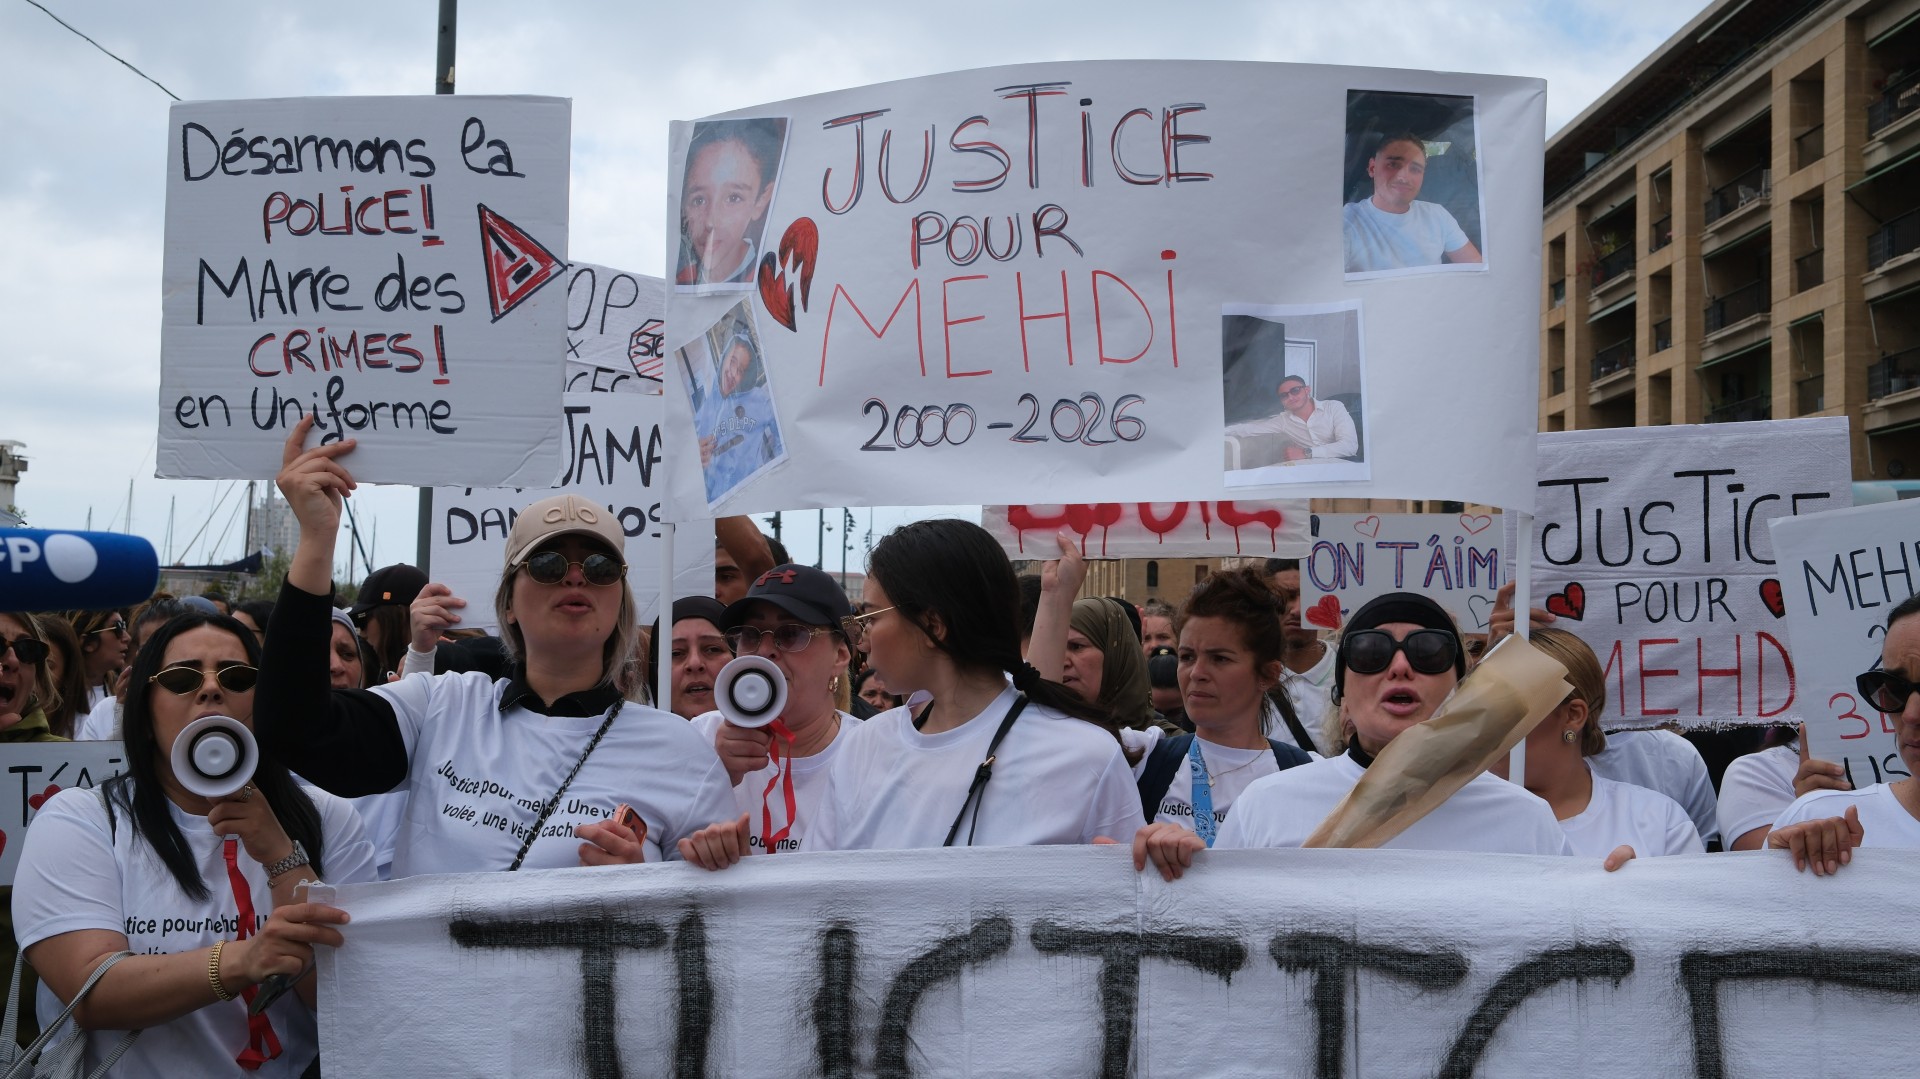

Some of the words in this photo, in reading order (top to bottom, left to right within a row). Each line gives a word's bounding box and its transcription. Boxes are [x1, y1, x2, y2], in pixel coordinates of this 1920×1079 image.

[182, 121, 436, 182] Désarmons
[461, 117, 526, 179] la
[911, 203, 1083, 269] POUR
[375, 253, 465, 314] des
[567, 267, 638, 334] OP
[175, 394, 231, 429] en
[251, 376, 457, 447] Uniforme
[562, 406, 662, 487] JAMA
[447, 507, 518, 545] DA
[543, 496, 598, 524] alo
[1308, 541, 1364, 592] ON
[1803, 541, 1920, 616] MEH
[1615, 578, 1737, 624] POUR
[1603, 631, 1796, 718] EHD
[438, 760, 479, 794] Justice
[479, 780, 515, 798] pour
[602, 808, 615, 819] vi
[483, 812, 507, 831] une
[542, 822, 580, 838] cach
[777, 838, 802, 850] me
[124, 916, 157, 935] tice
[162, 918, 203, 937] pour
